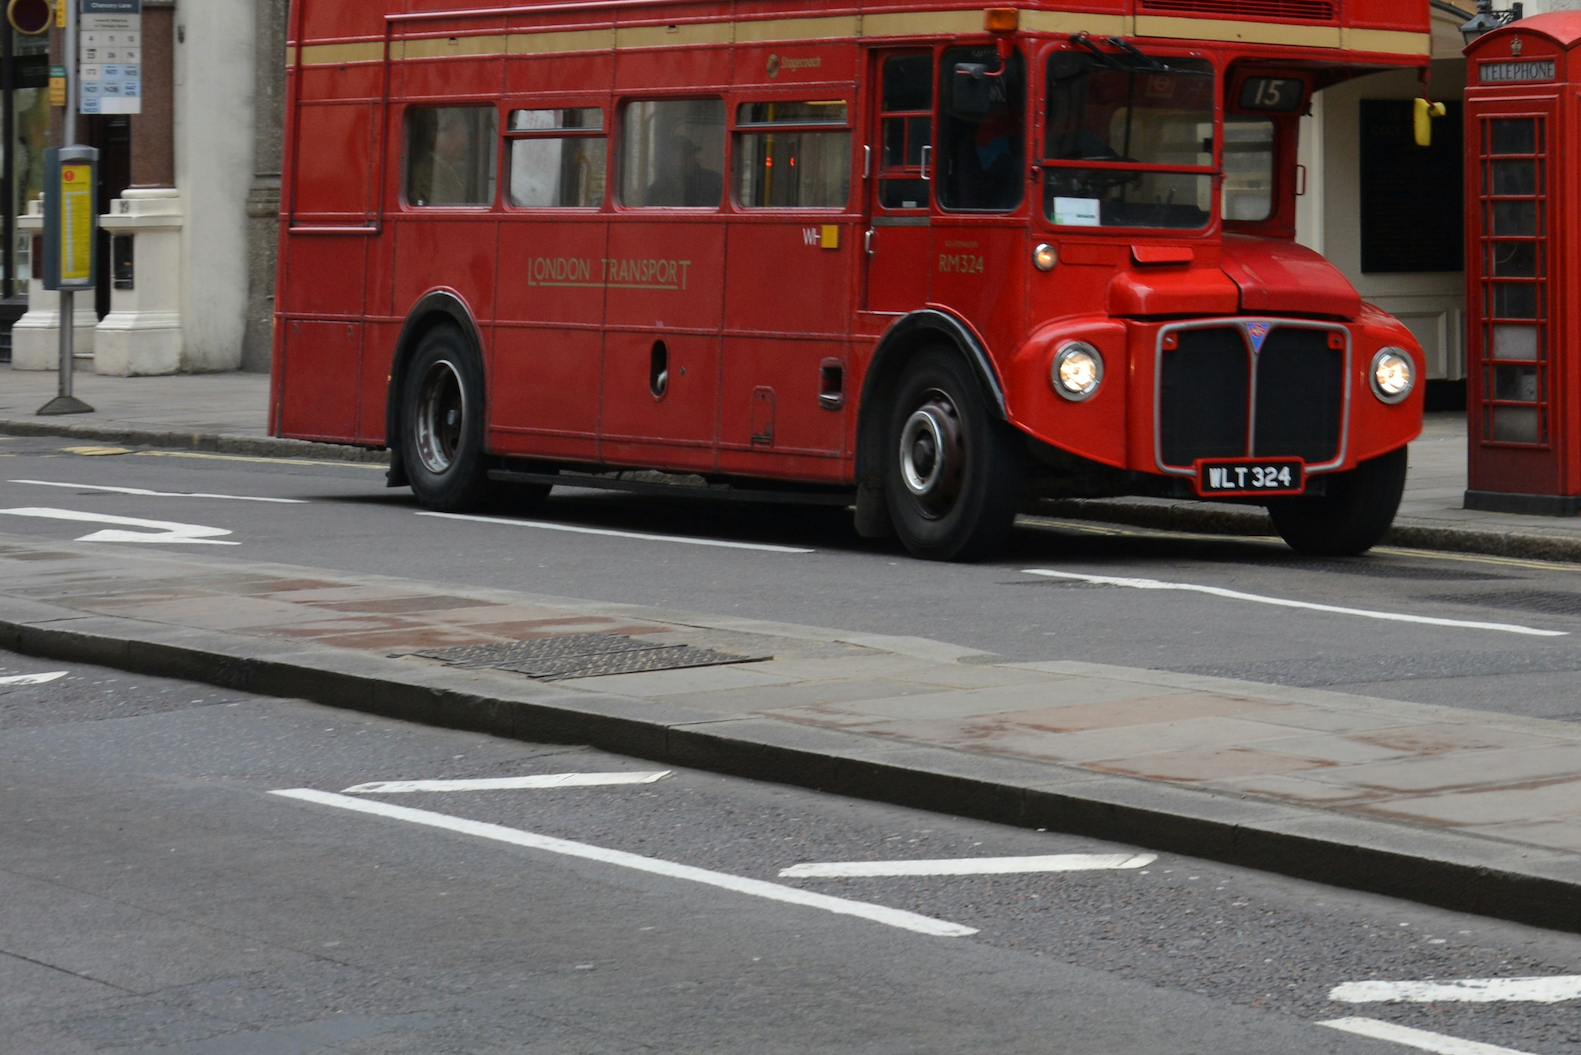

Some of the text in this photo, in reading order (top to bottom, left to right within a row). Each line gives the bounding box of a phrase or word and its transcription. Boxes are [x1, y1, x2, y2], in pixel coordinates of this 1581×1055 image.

[780, 56, 821, 72] Stagecoach
[1483, 62, 1555, 81] TELEPHONE
[1254, 79, 1285, 106] 15
[528, 257, 691, 290] LONDON TRANSPORT
[938, 253, 984, 273] RM324
[1209, 466, 1292, 488] WLT 324
